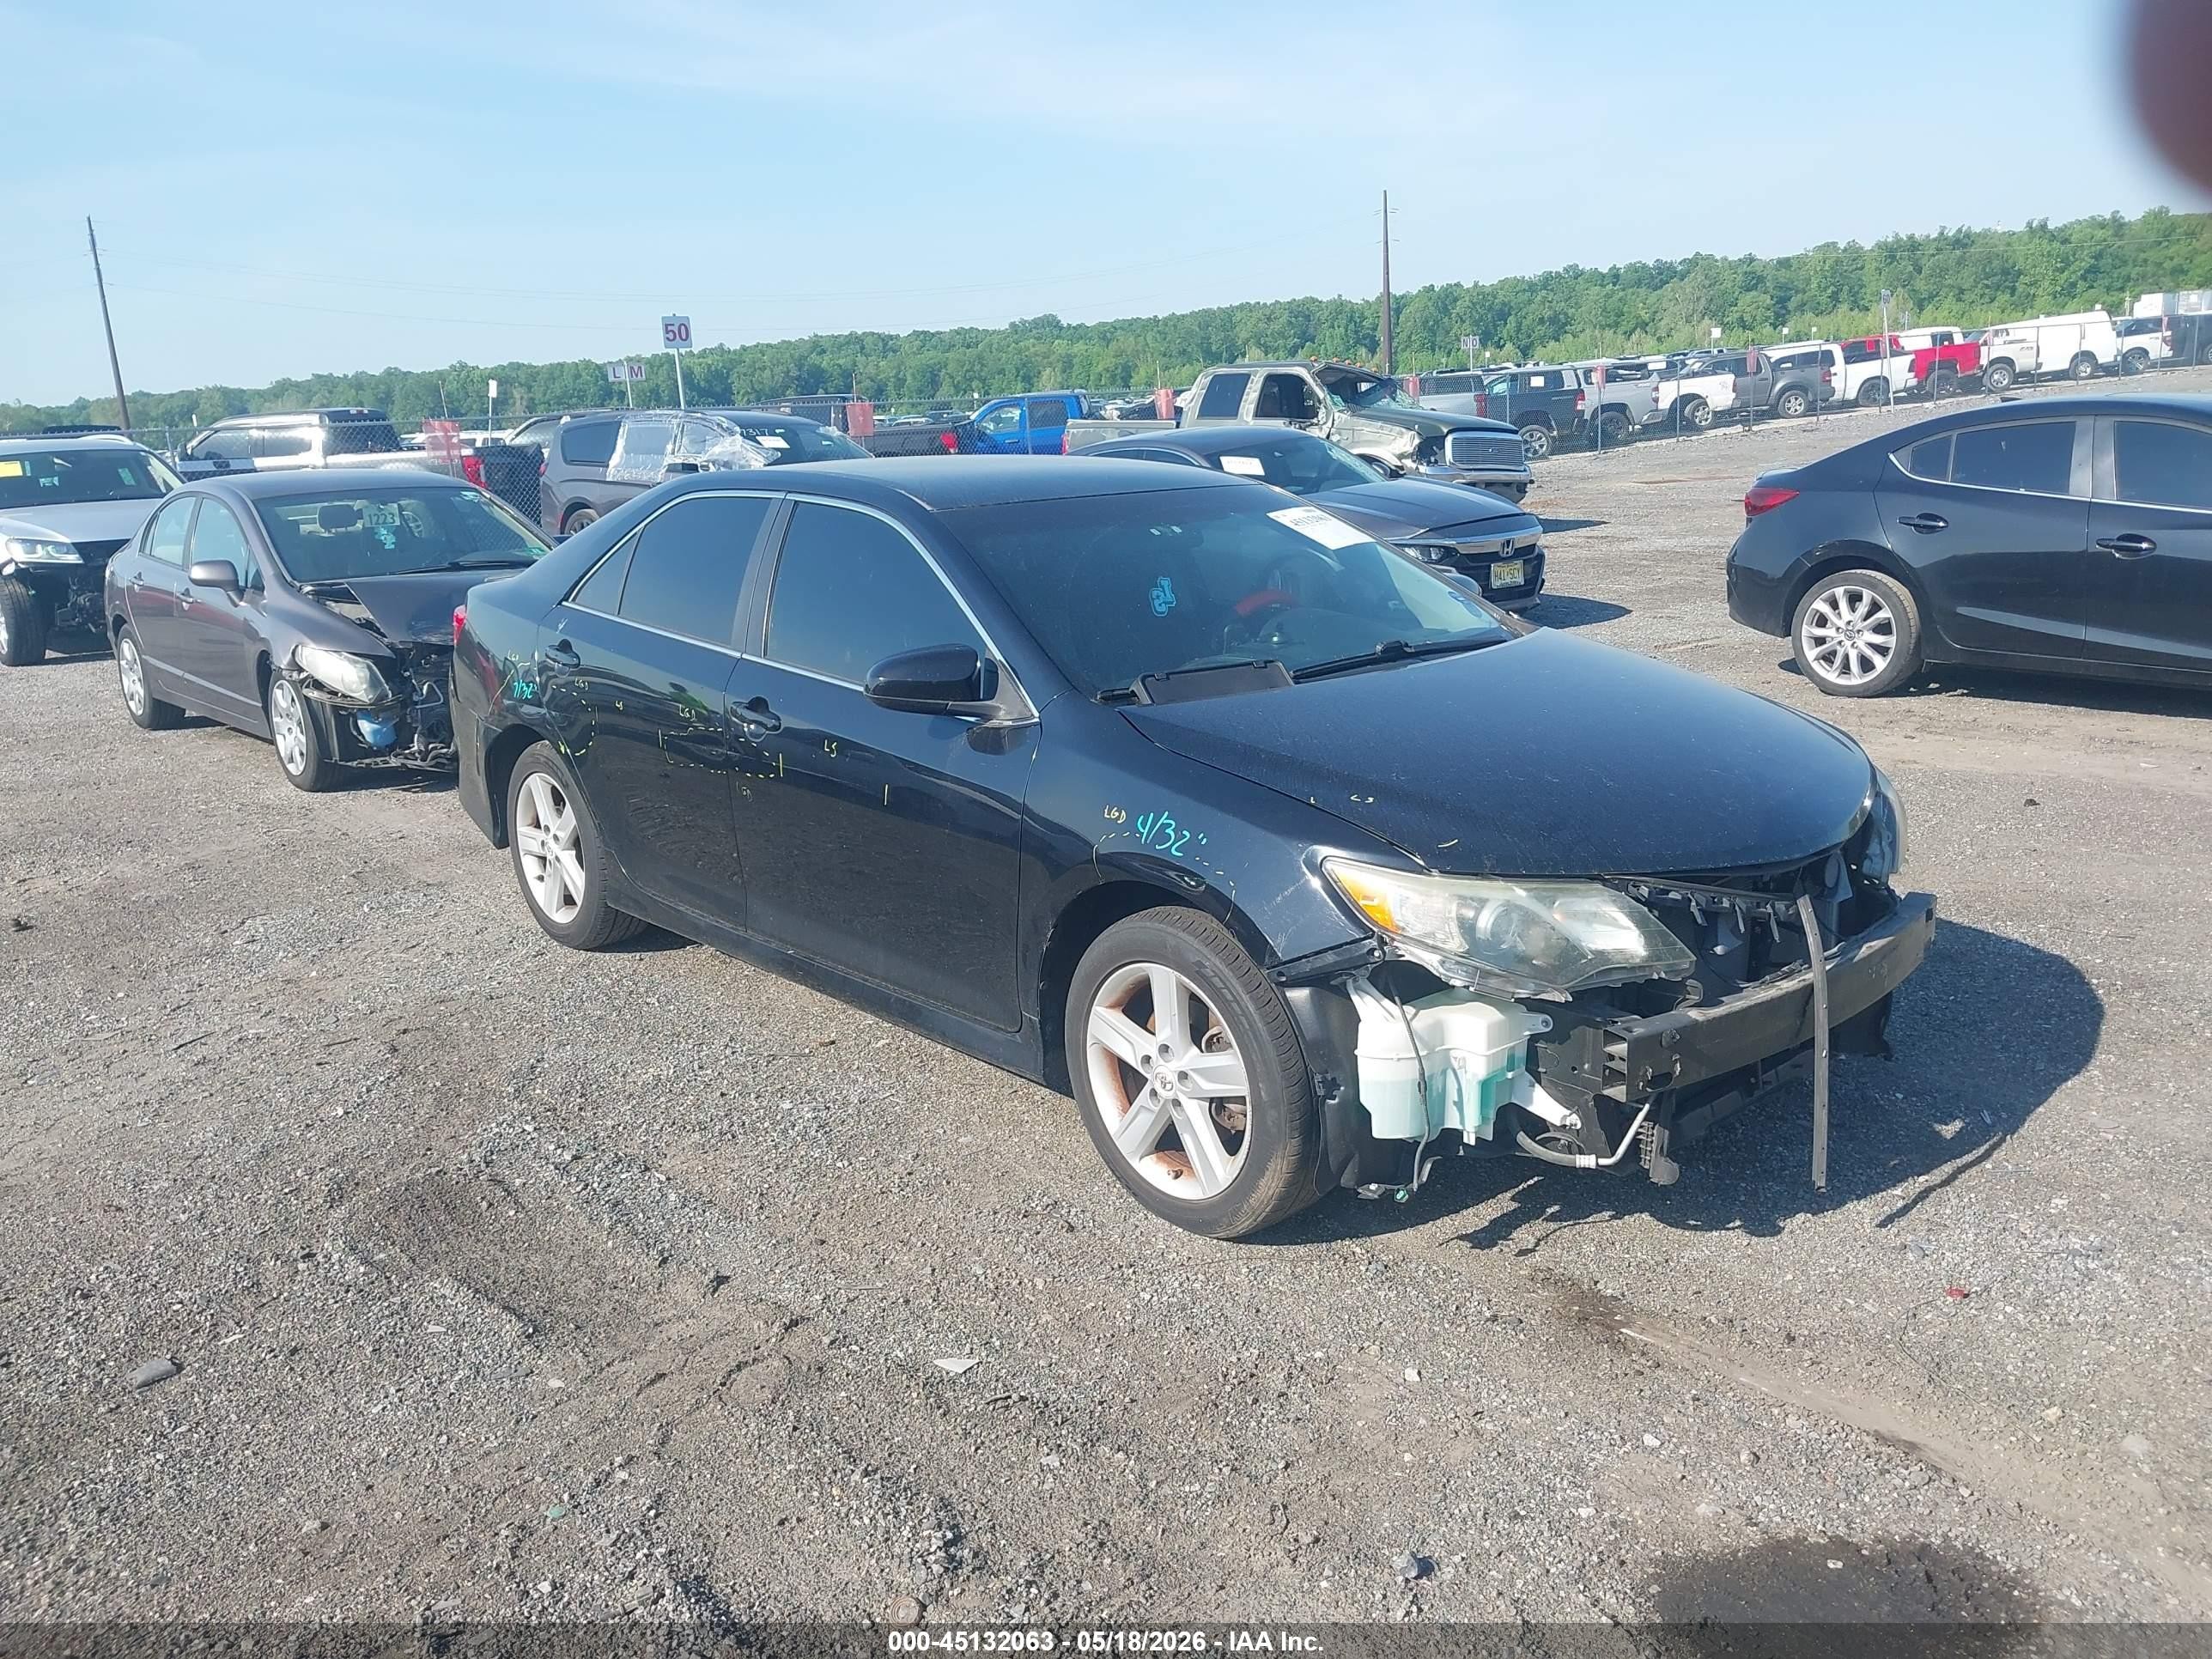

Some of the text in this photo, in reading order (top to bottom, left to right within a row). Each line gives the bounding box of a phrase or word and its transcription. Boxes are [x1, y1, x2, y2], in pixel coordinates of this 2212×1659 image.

[664, 323, 690, 342] 50
[612, 366, 643, 379] L M
[368, 512, 396, 526] 1223
[1103, 804, 1127, 824] LGD
